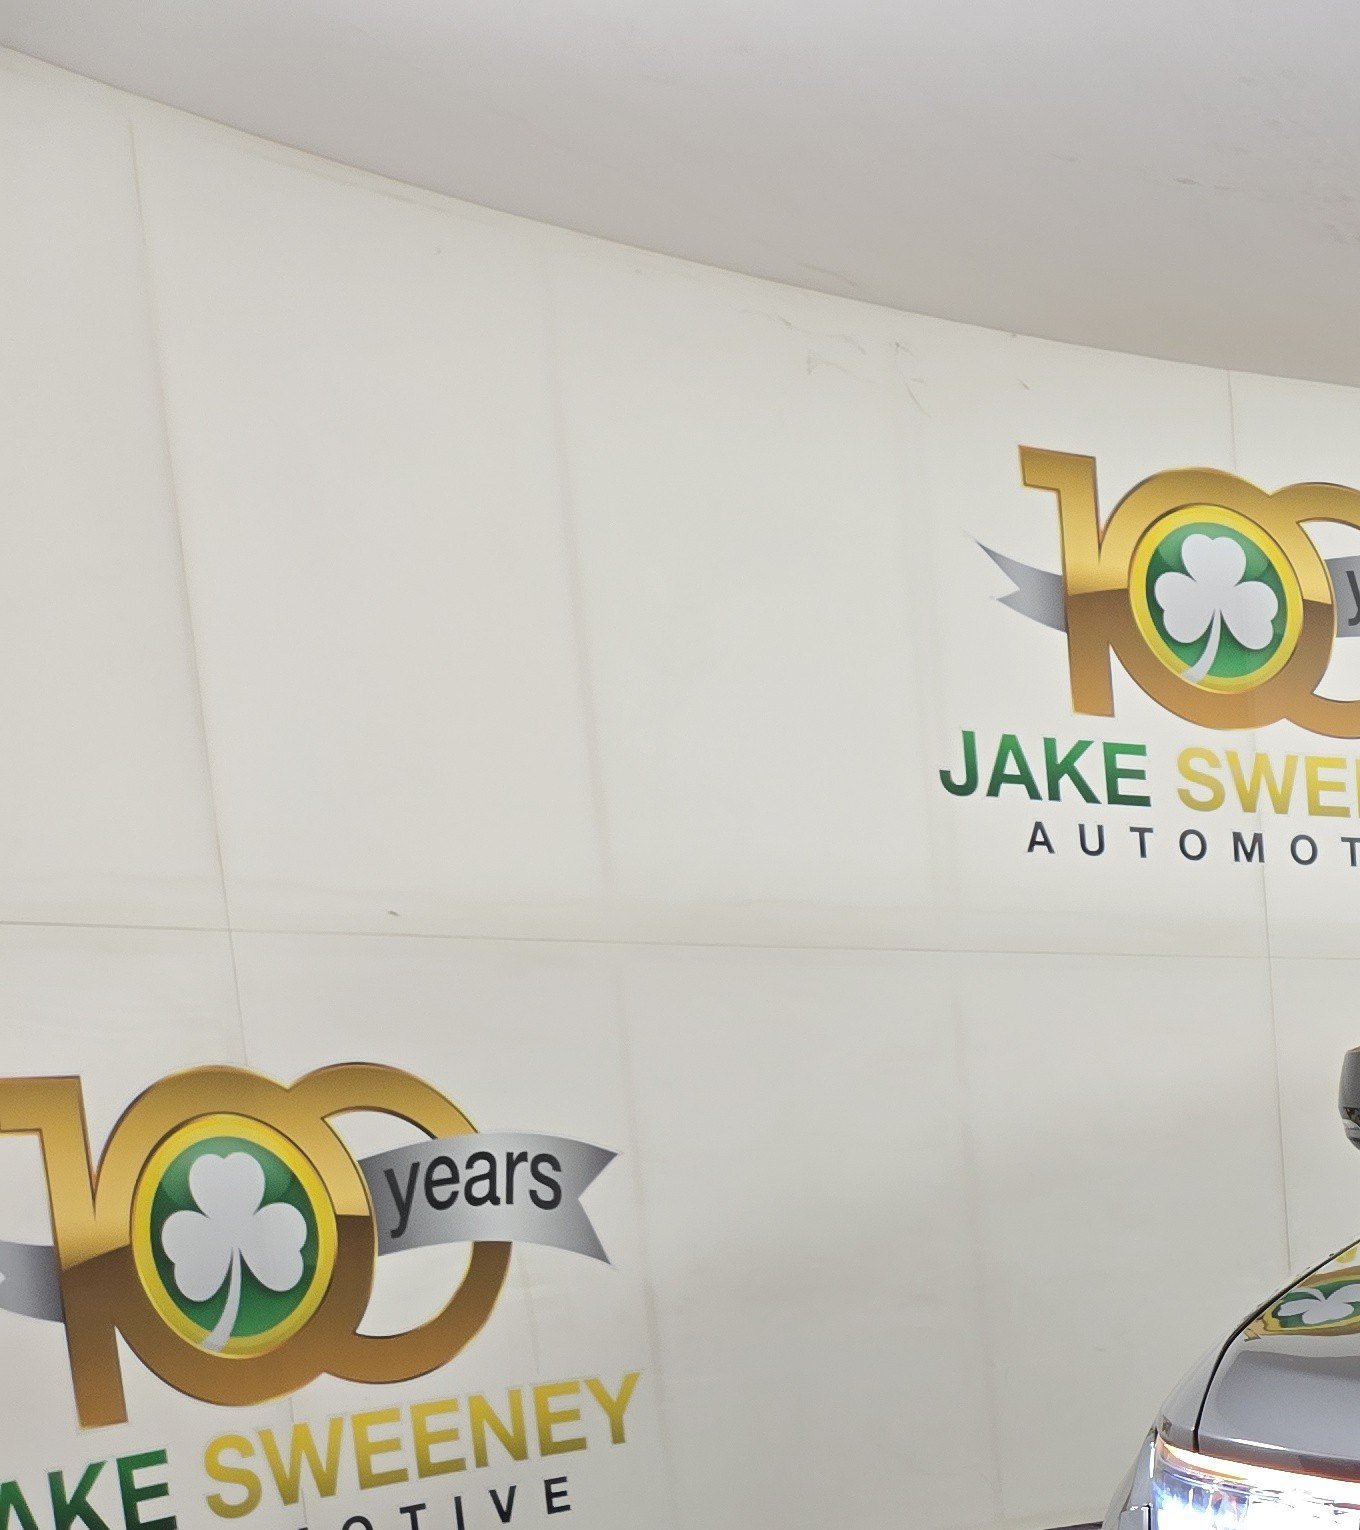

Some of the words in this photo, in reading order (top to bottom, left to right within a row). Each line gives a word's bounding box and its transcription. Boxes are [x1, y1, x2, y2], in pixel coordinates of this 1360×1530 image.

[939, 730, 1151, 807] JAKE
[384, 1150, 563, 1239] years
[203, 1373, 639, 1518] SWEENEY
